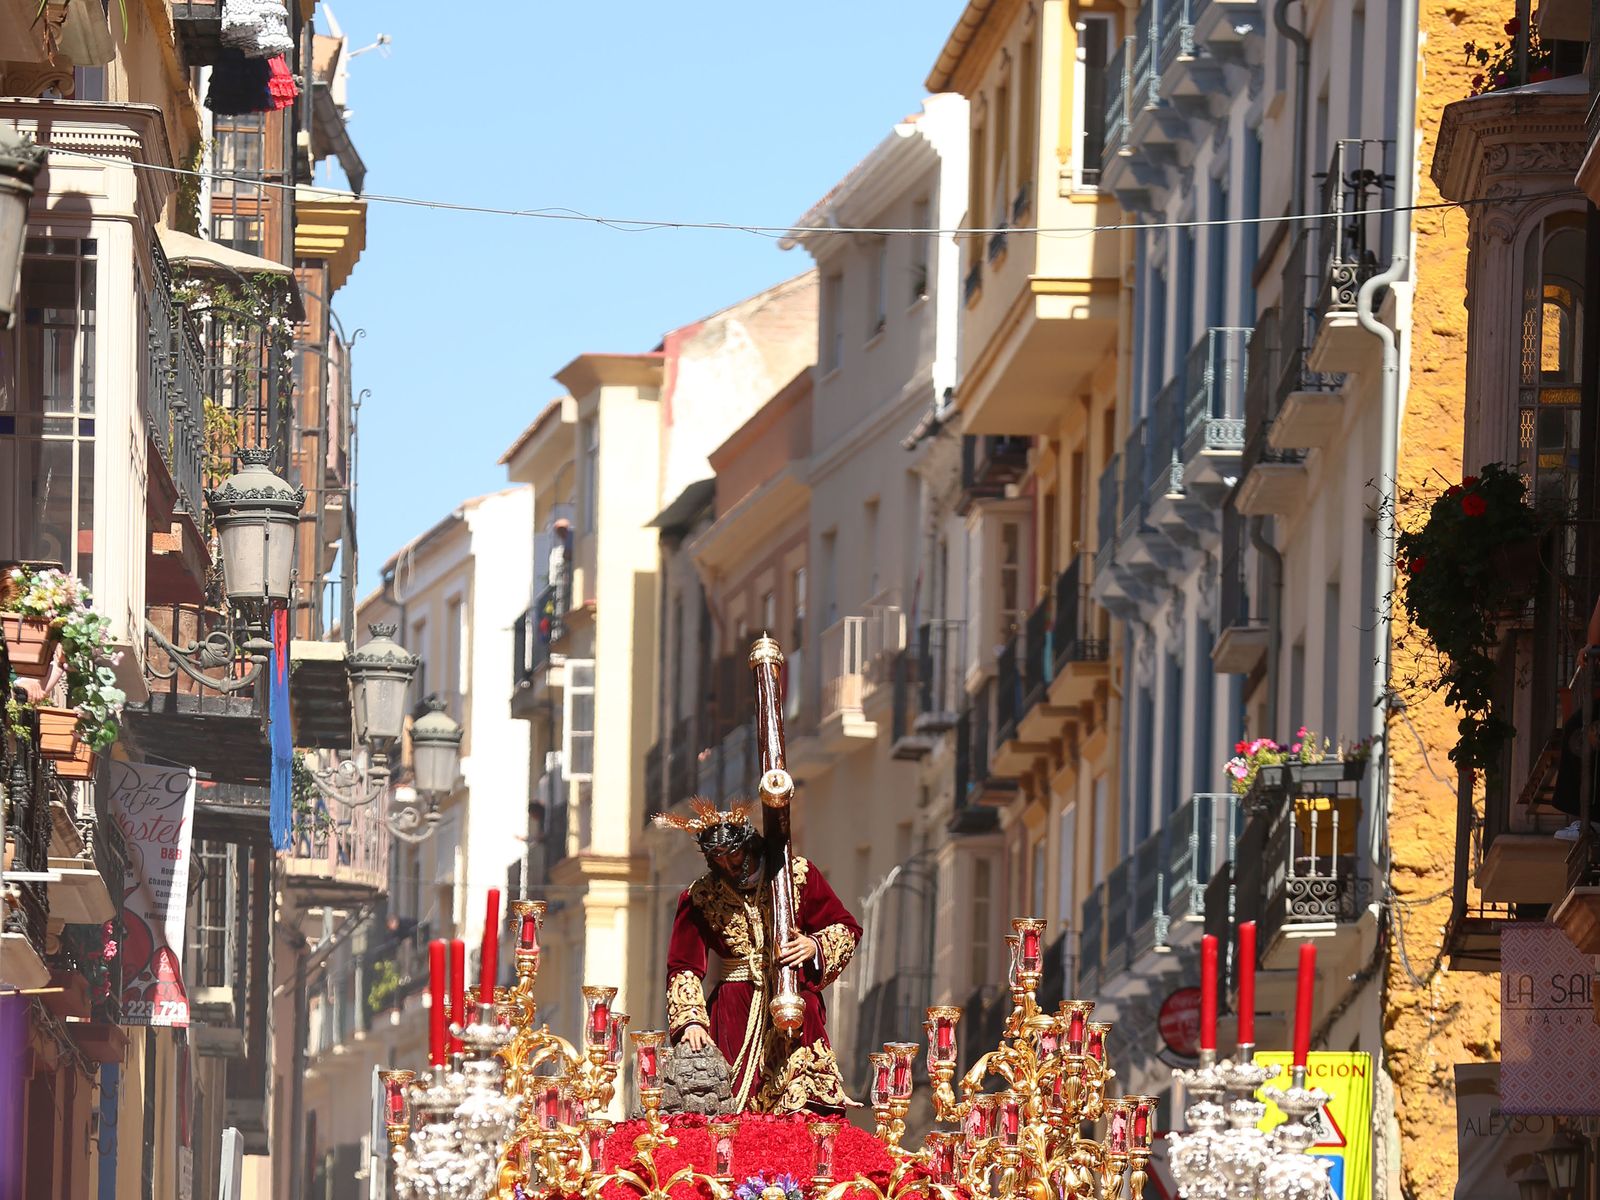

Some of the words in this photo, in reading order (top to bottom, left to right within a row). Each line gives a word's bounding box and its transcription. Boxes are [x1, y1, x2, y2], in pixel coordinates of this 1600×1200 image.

[109, 760, 160, 815] Patio
[148, 771, 190, 810] 19
[160, 847, 182, 860] B&B
[1506, 974, 1534, 1003] LA
